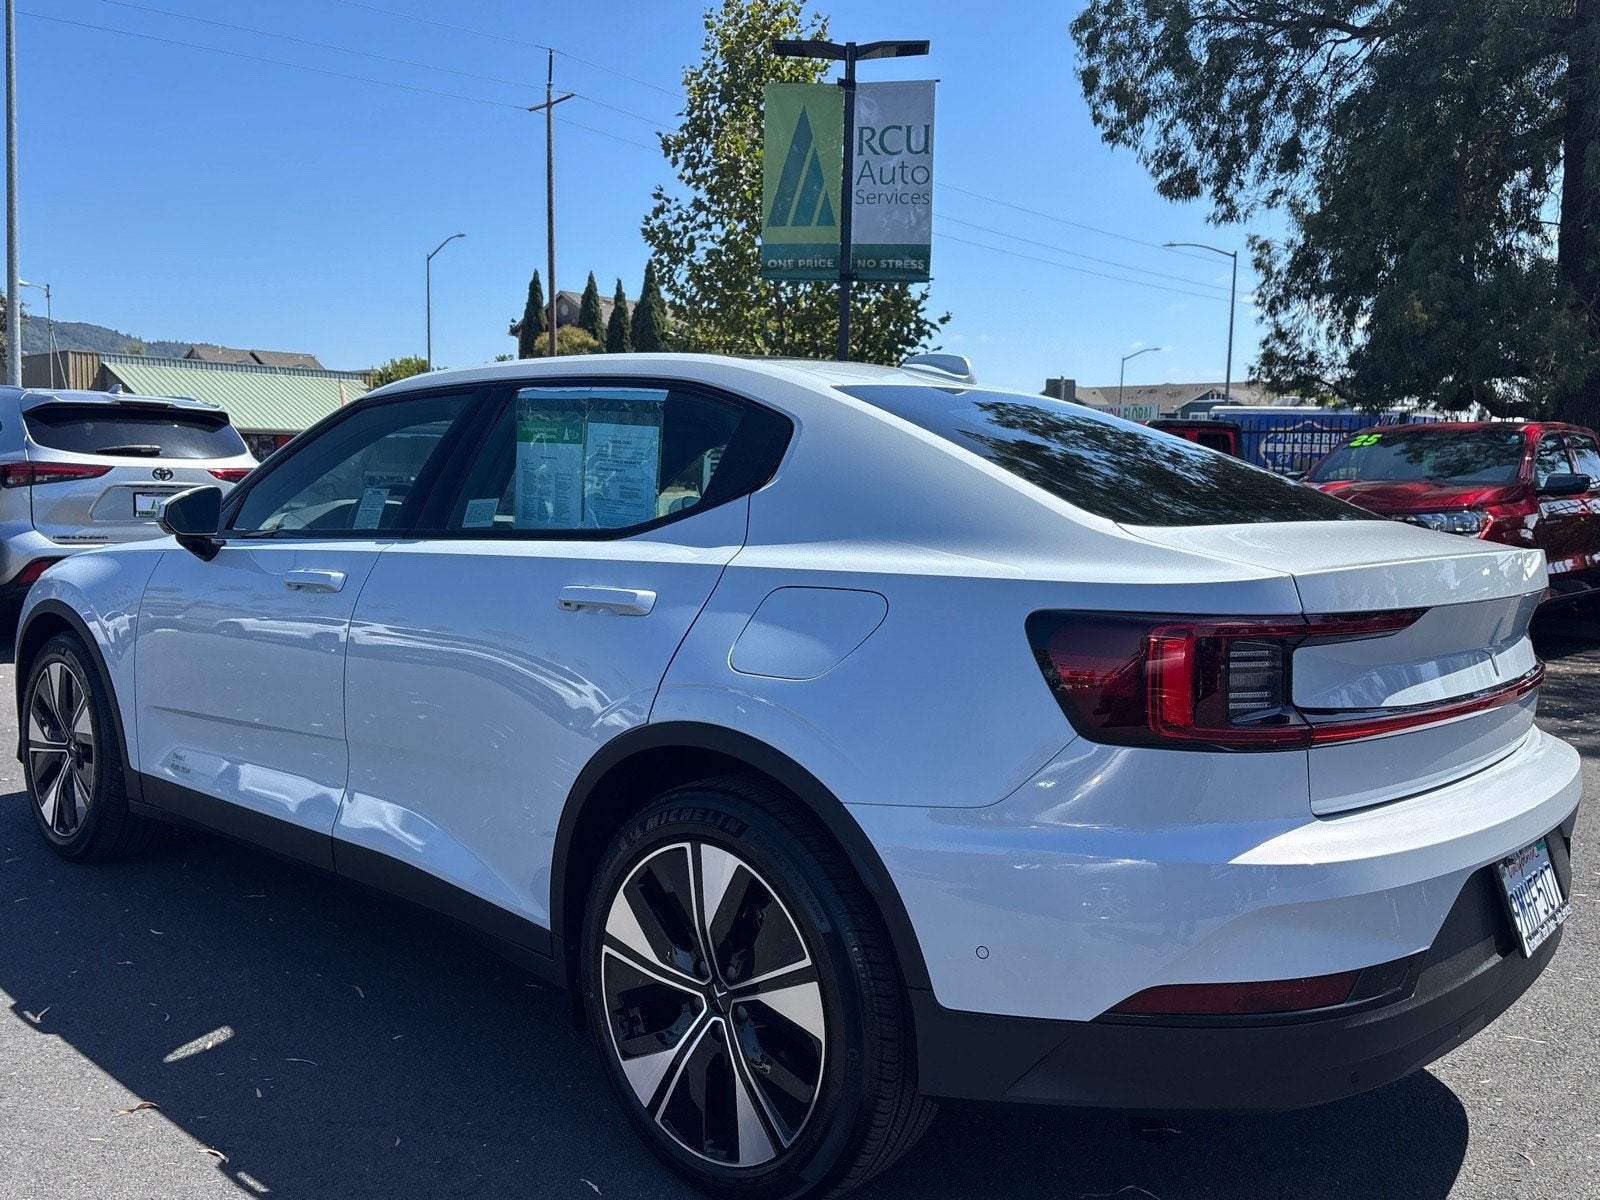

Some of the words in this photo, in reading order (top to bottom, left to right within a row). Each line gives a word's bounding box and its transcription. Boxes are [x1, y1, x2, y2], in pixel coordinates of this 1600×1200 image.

[857, 124, 931, 156] RCU
[856, 159, 931, 186] Auto
[855, 188, 930, 205] Services
[767, 258, 795, 268] ONE
[797, 258, 834, 268] PRICE
[856, 258, 877, 268] NO
[879, 258, 925, 270] STRESS
[1349, 433, 1383, 447] 25
[645, 806, 743, 834] MICHELIN
[753, 834, 793, 872] PRIMACY
[803, 888, 827, 923] SEASON
[1508, 861, 1563, 935] 9MHF507
